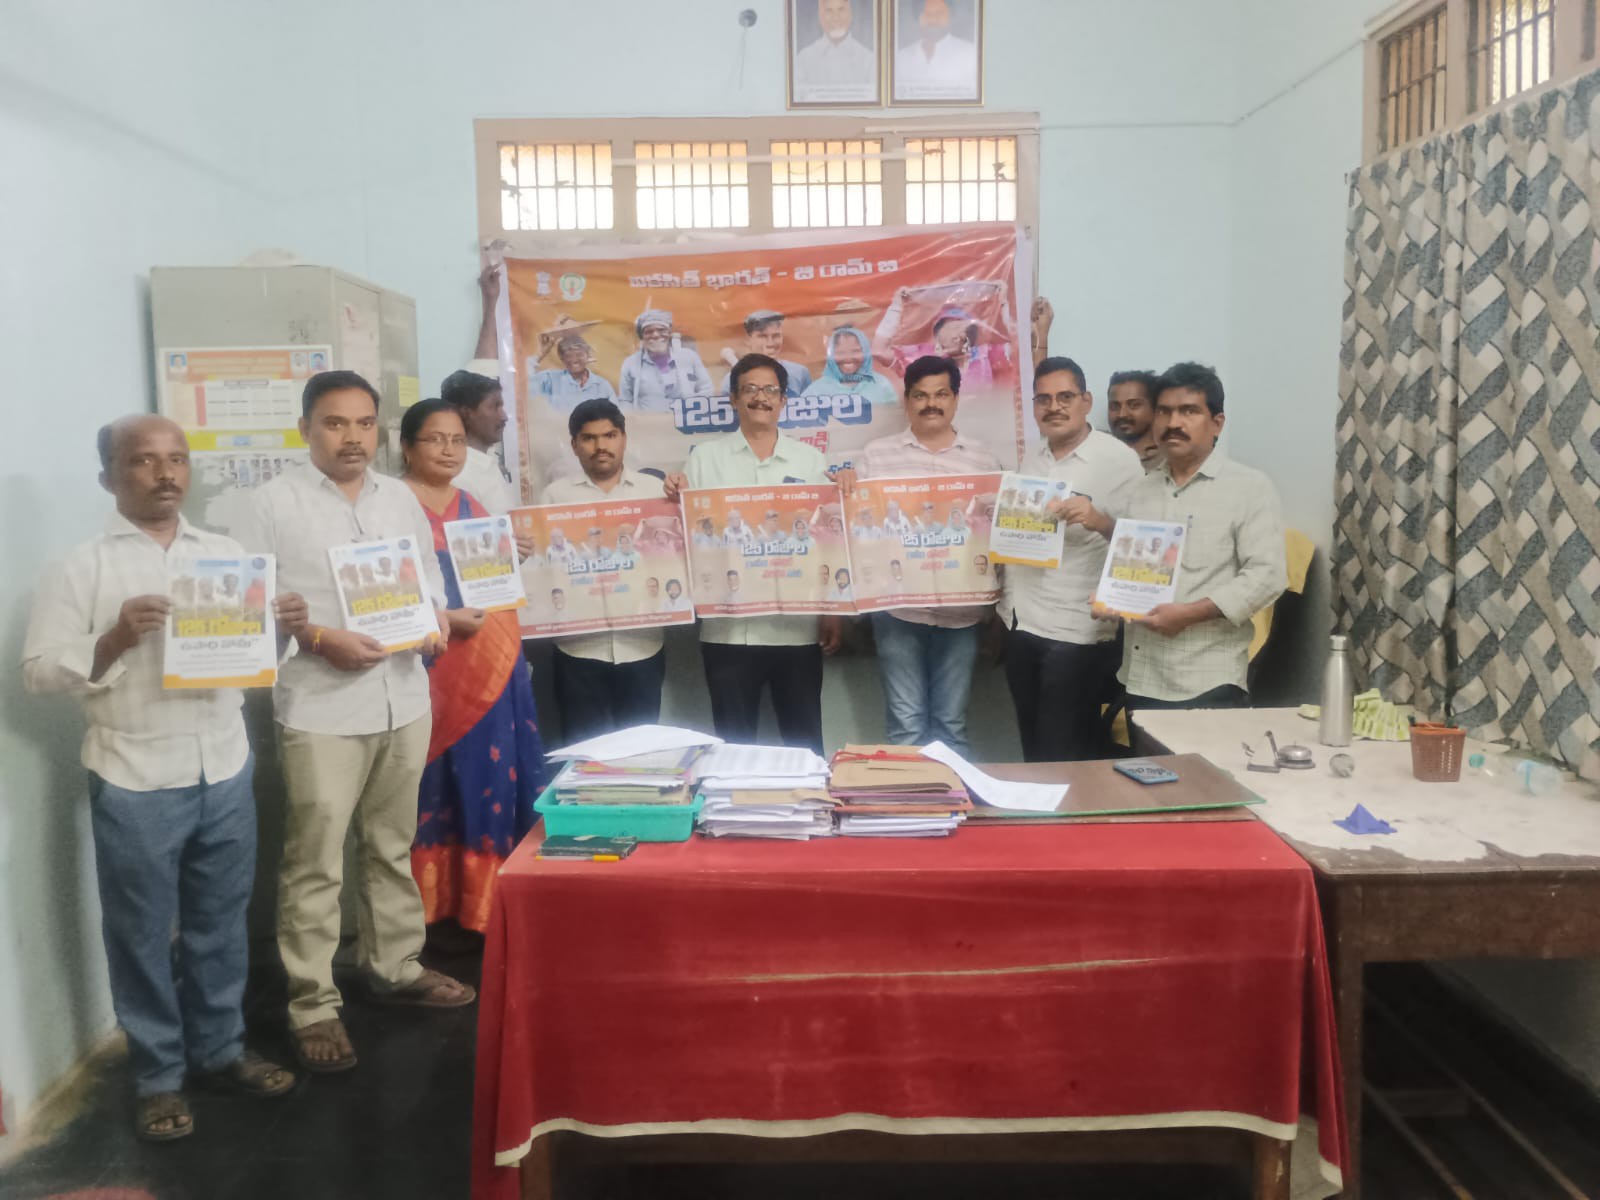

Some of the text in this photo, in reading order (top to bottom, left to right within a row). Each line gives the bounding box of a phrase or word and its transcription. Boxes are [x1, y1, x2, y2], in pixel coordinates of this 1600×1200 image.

[819, 257, 873, 278] రామ్
[669, 392, 866, 431] 125 జుల
